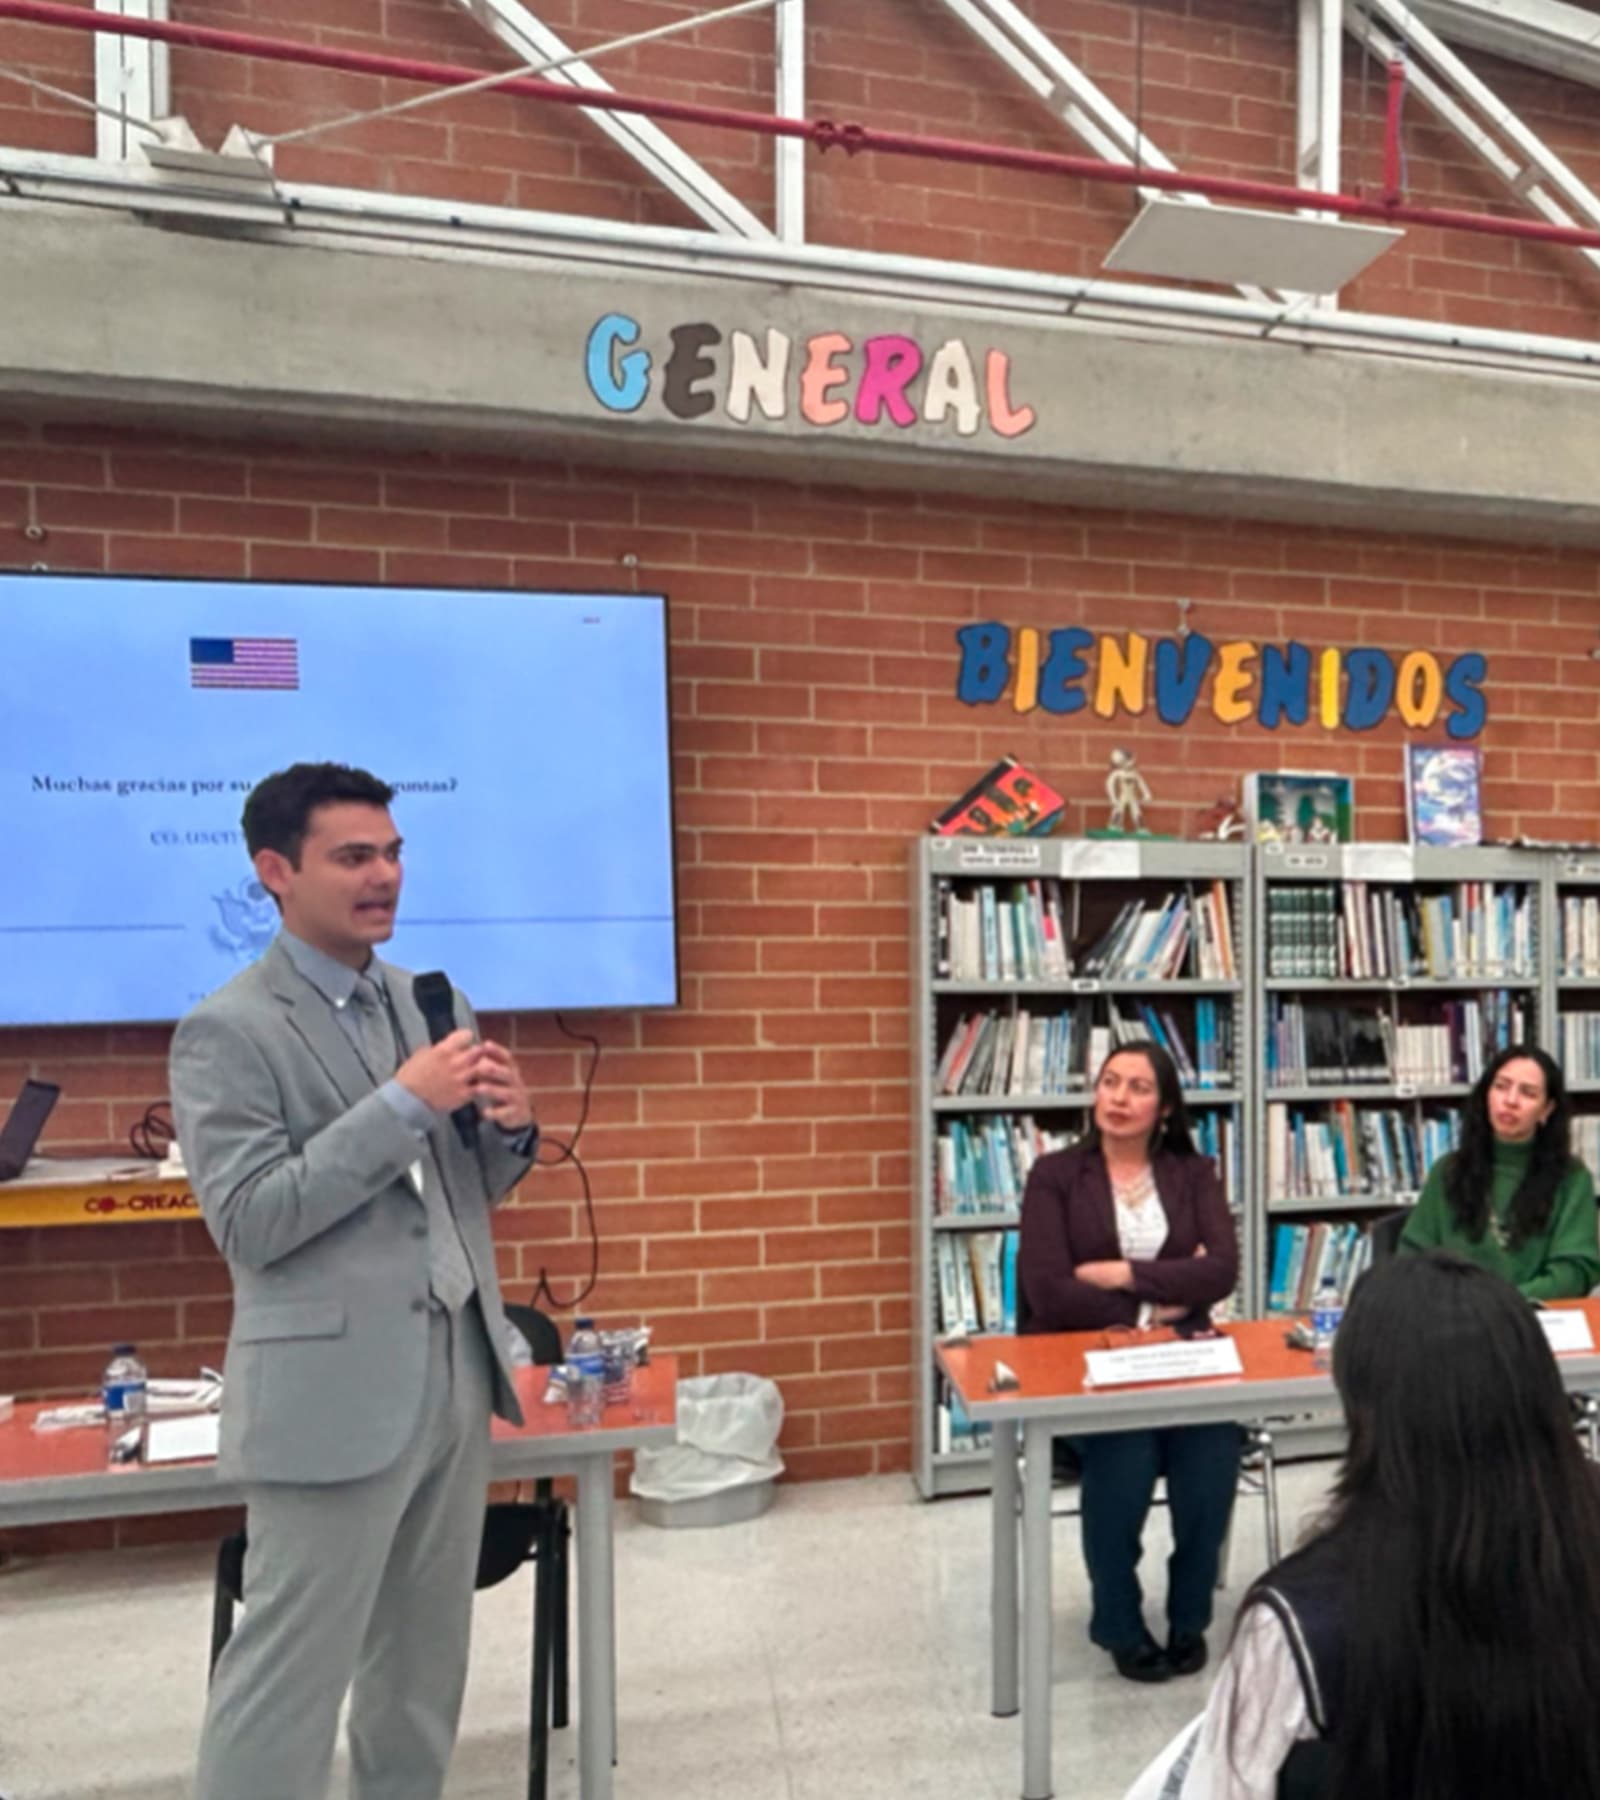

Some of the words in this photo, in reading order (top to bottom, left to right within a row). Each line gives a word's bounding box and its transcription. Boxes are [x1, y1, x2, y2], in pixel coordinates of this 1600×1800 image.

[585, 312, 1036, 439] GENERAL
[957, 621, 1488, 739] BIENVENIDOS
[31, 776, 112, 792] Muchas
[116, 778, 187, 796] gracias
[191, 780, 225, 796] por
